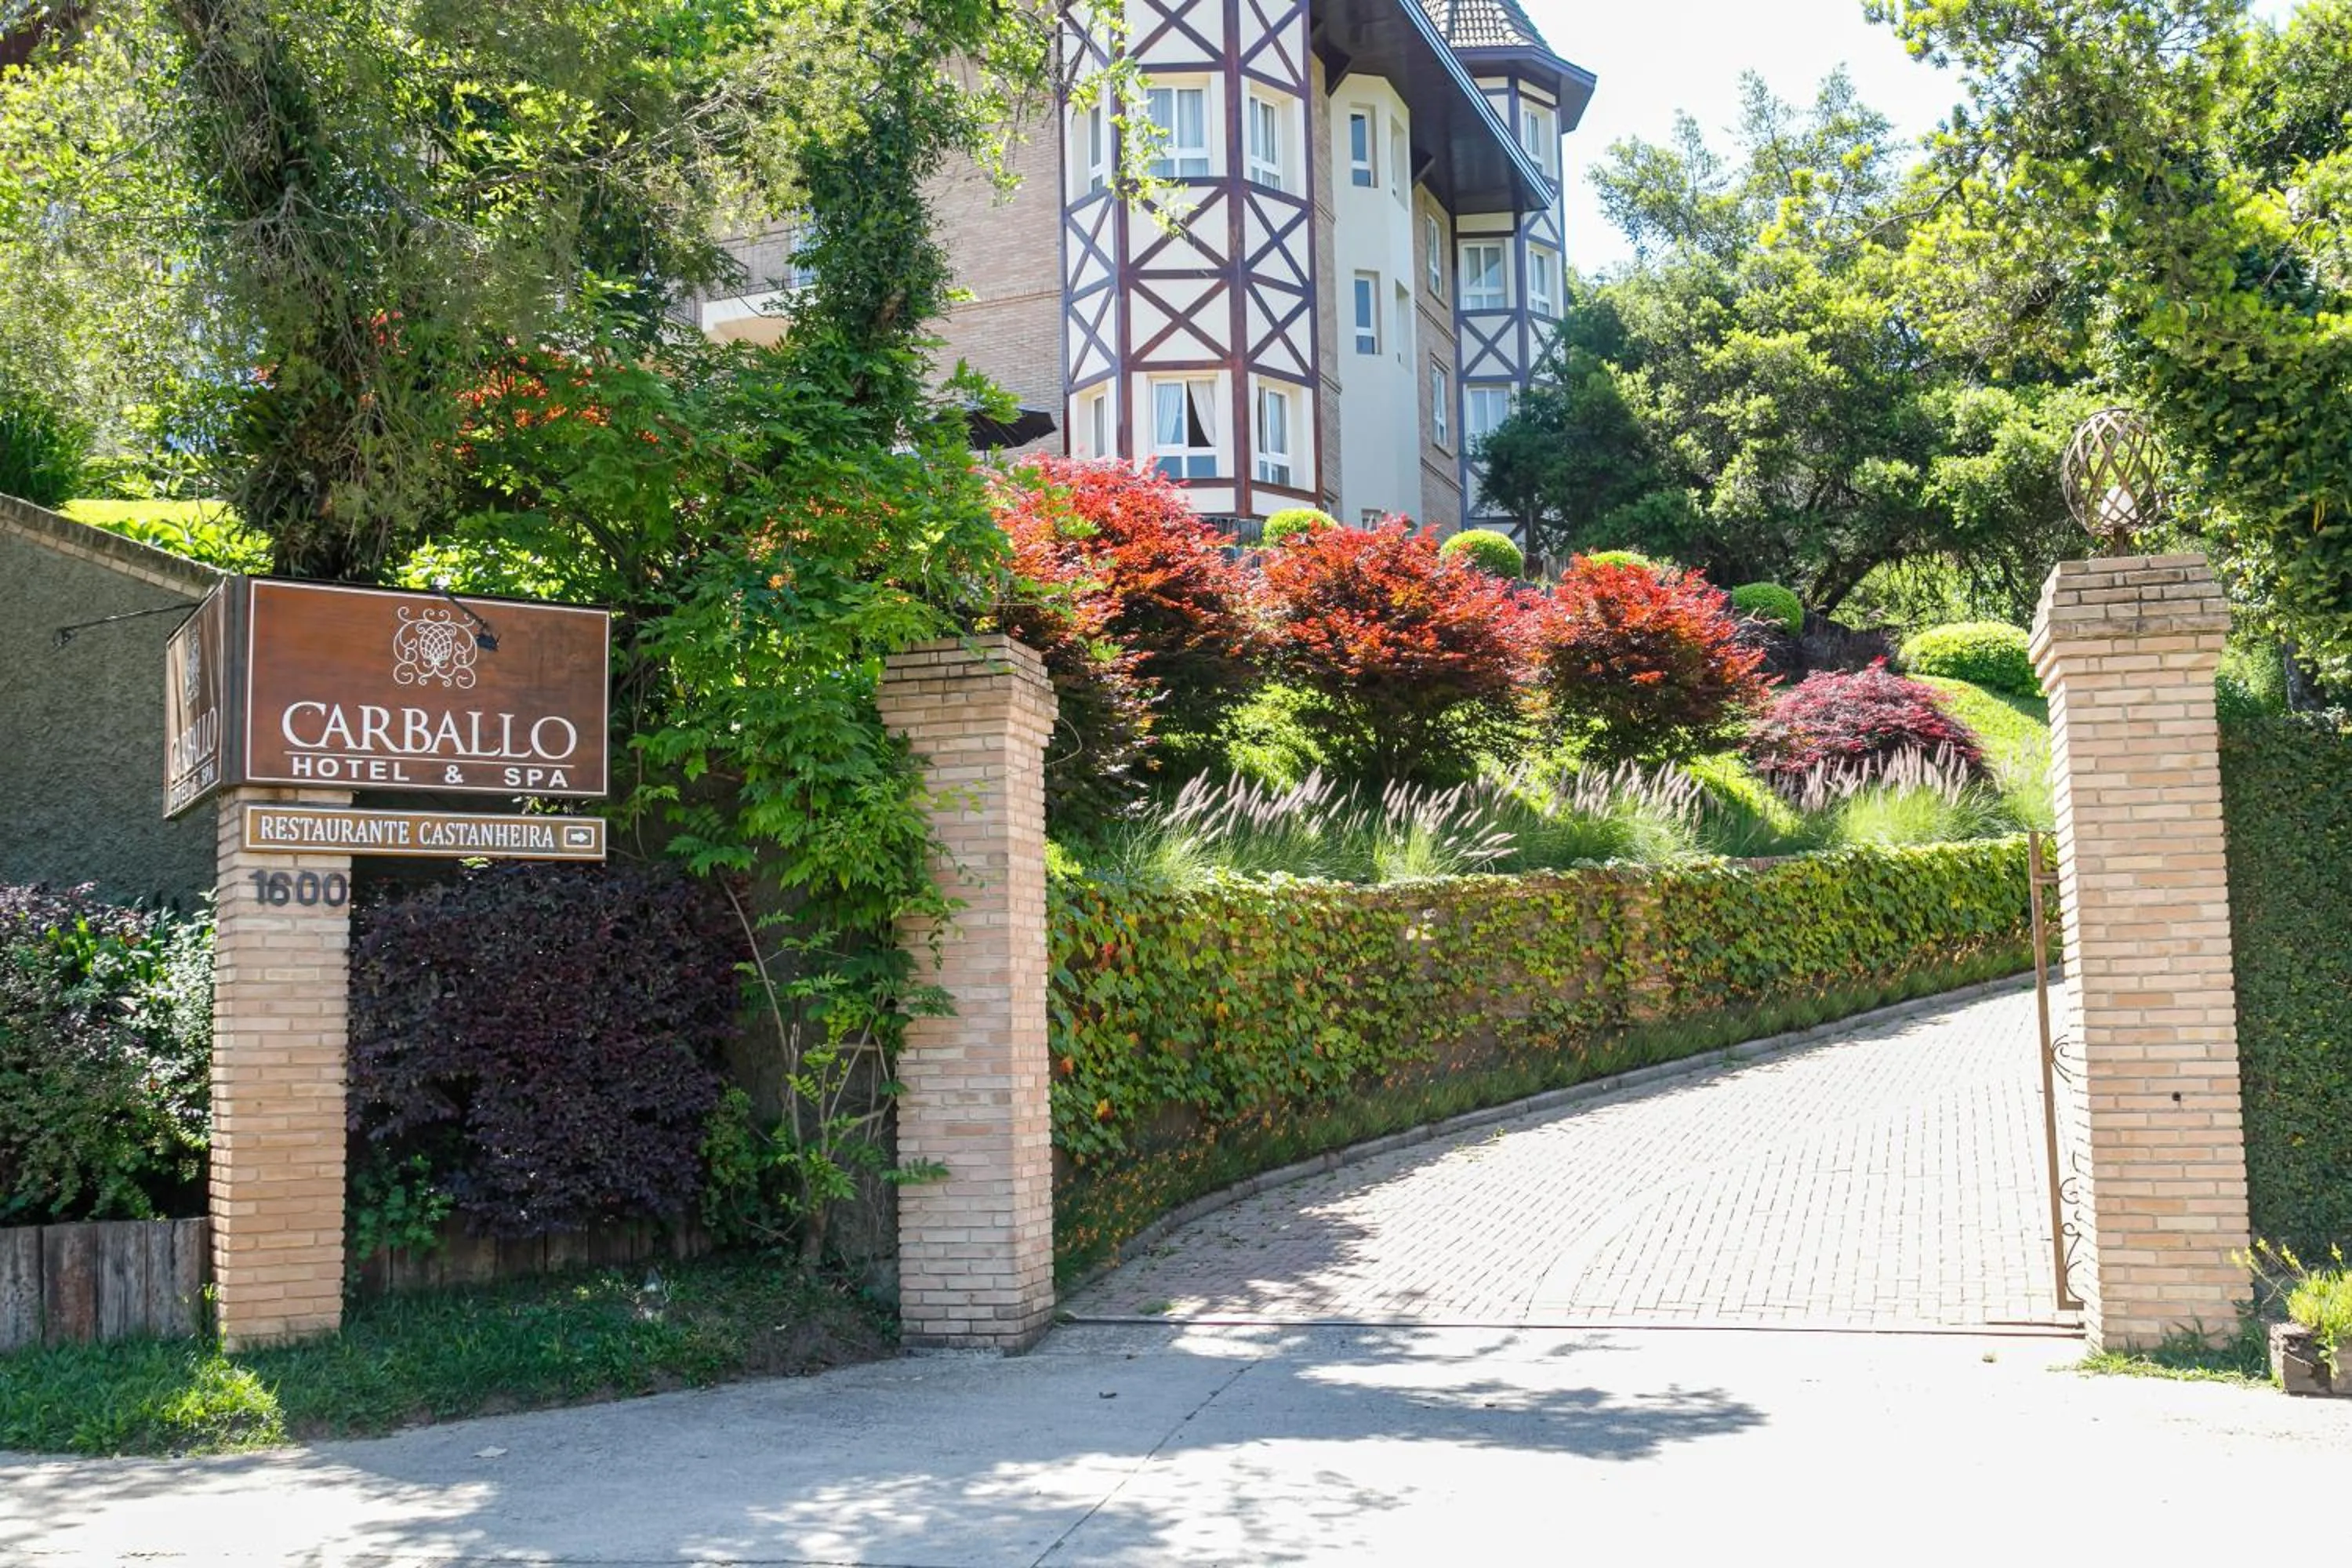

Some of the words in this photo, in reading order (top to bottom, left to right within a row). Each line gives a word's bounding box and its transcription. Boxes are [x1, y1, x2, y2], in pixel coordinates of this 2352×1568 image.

[281, 701, 578, 760] CARBALLO
[292, 757, 410, 782] HOTEL
[445, 764, 464, 784] &
[504, 768, 568, 788] SPA
[260, 815, 410, 844] RESTAURANTE
[419, 822, 554, 848] CASTANHEIRA
[249, 869, 347, 907] 1600
